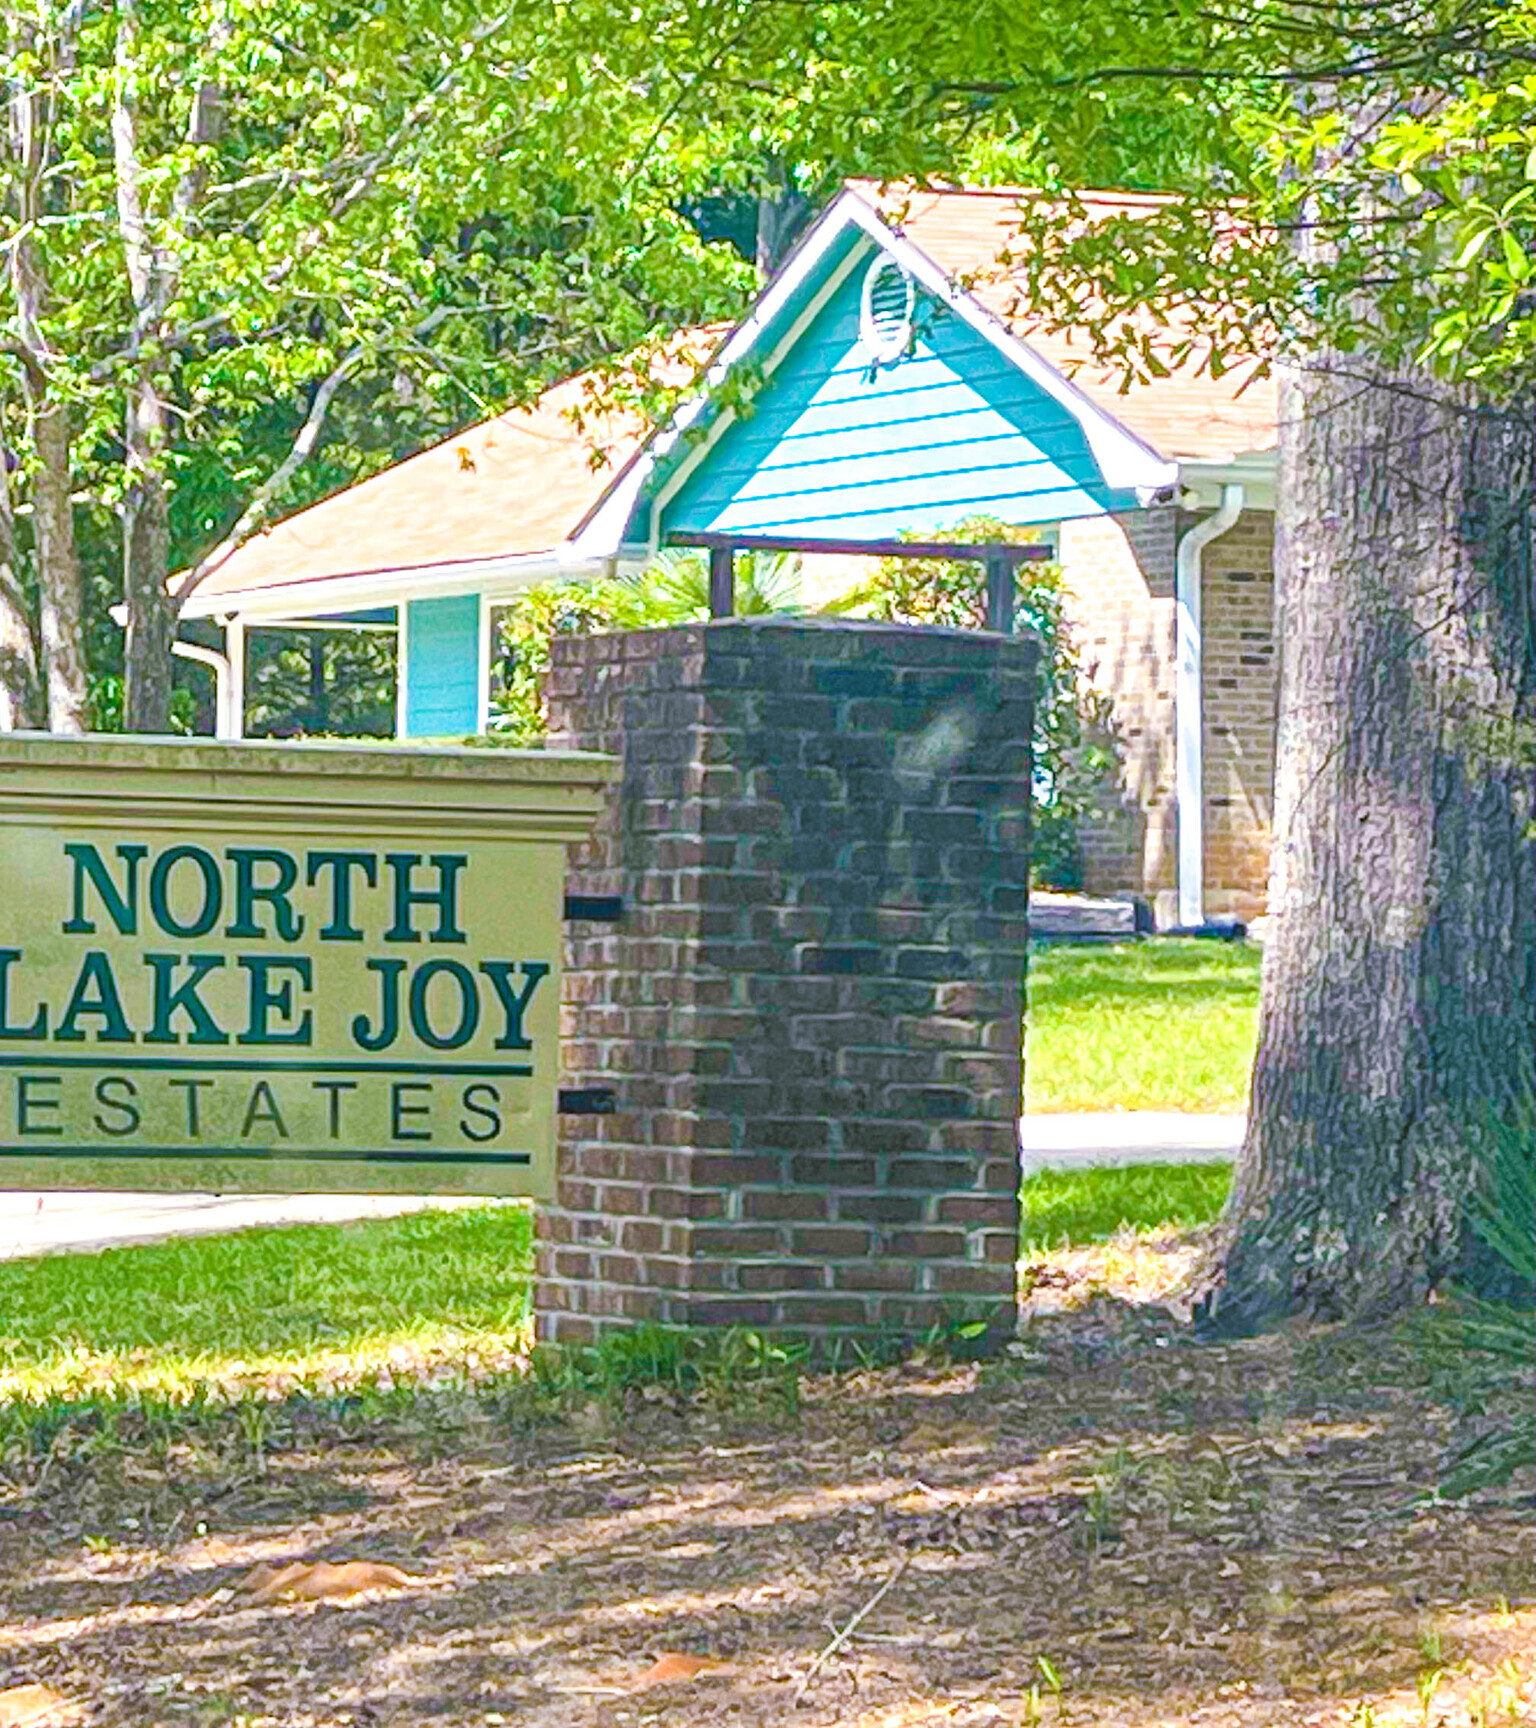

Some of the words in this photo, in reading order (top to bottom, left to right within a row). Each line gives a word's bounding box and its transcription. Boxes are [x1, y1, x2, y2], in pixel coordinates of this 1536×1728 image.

[62, 843, 468, 942] NORTH
[351, 958, 550, 1051] JOY
[16, 1075, 503, 1142] ESTATES
